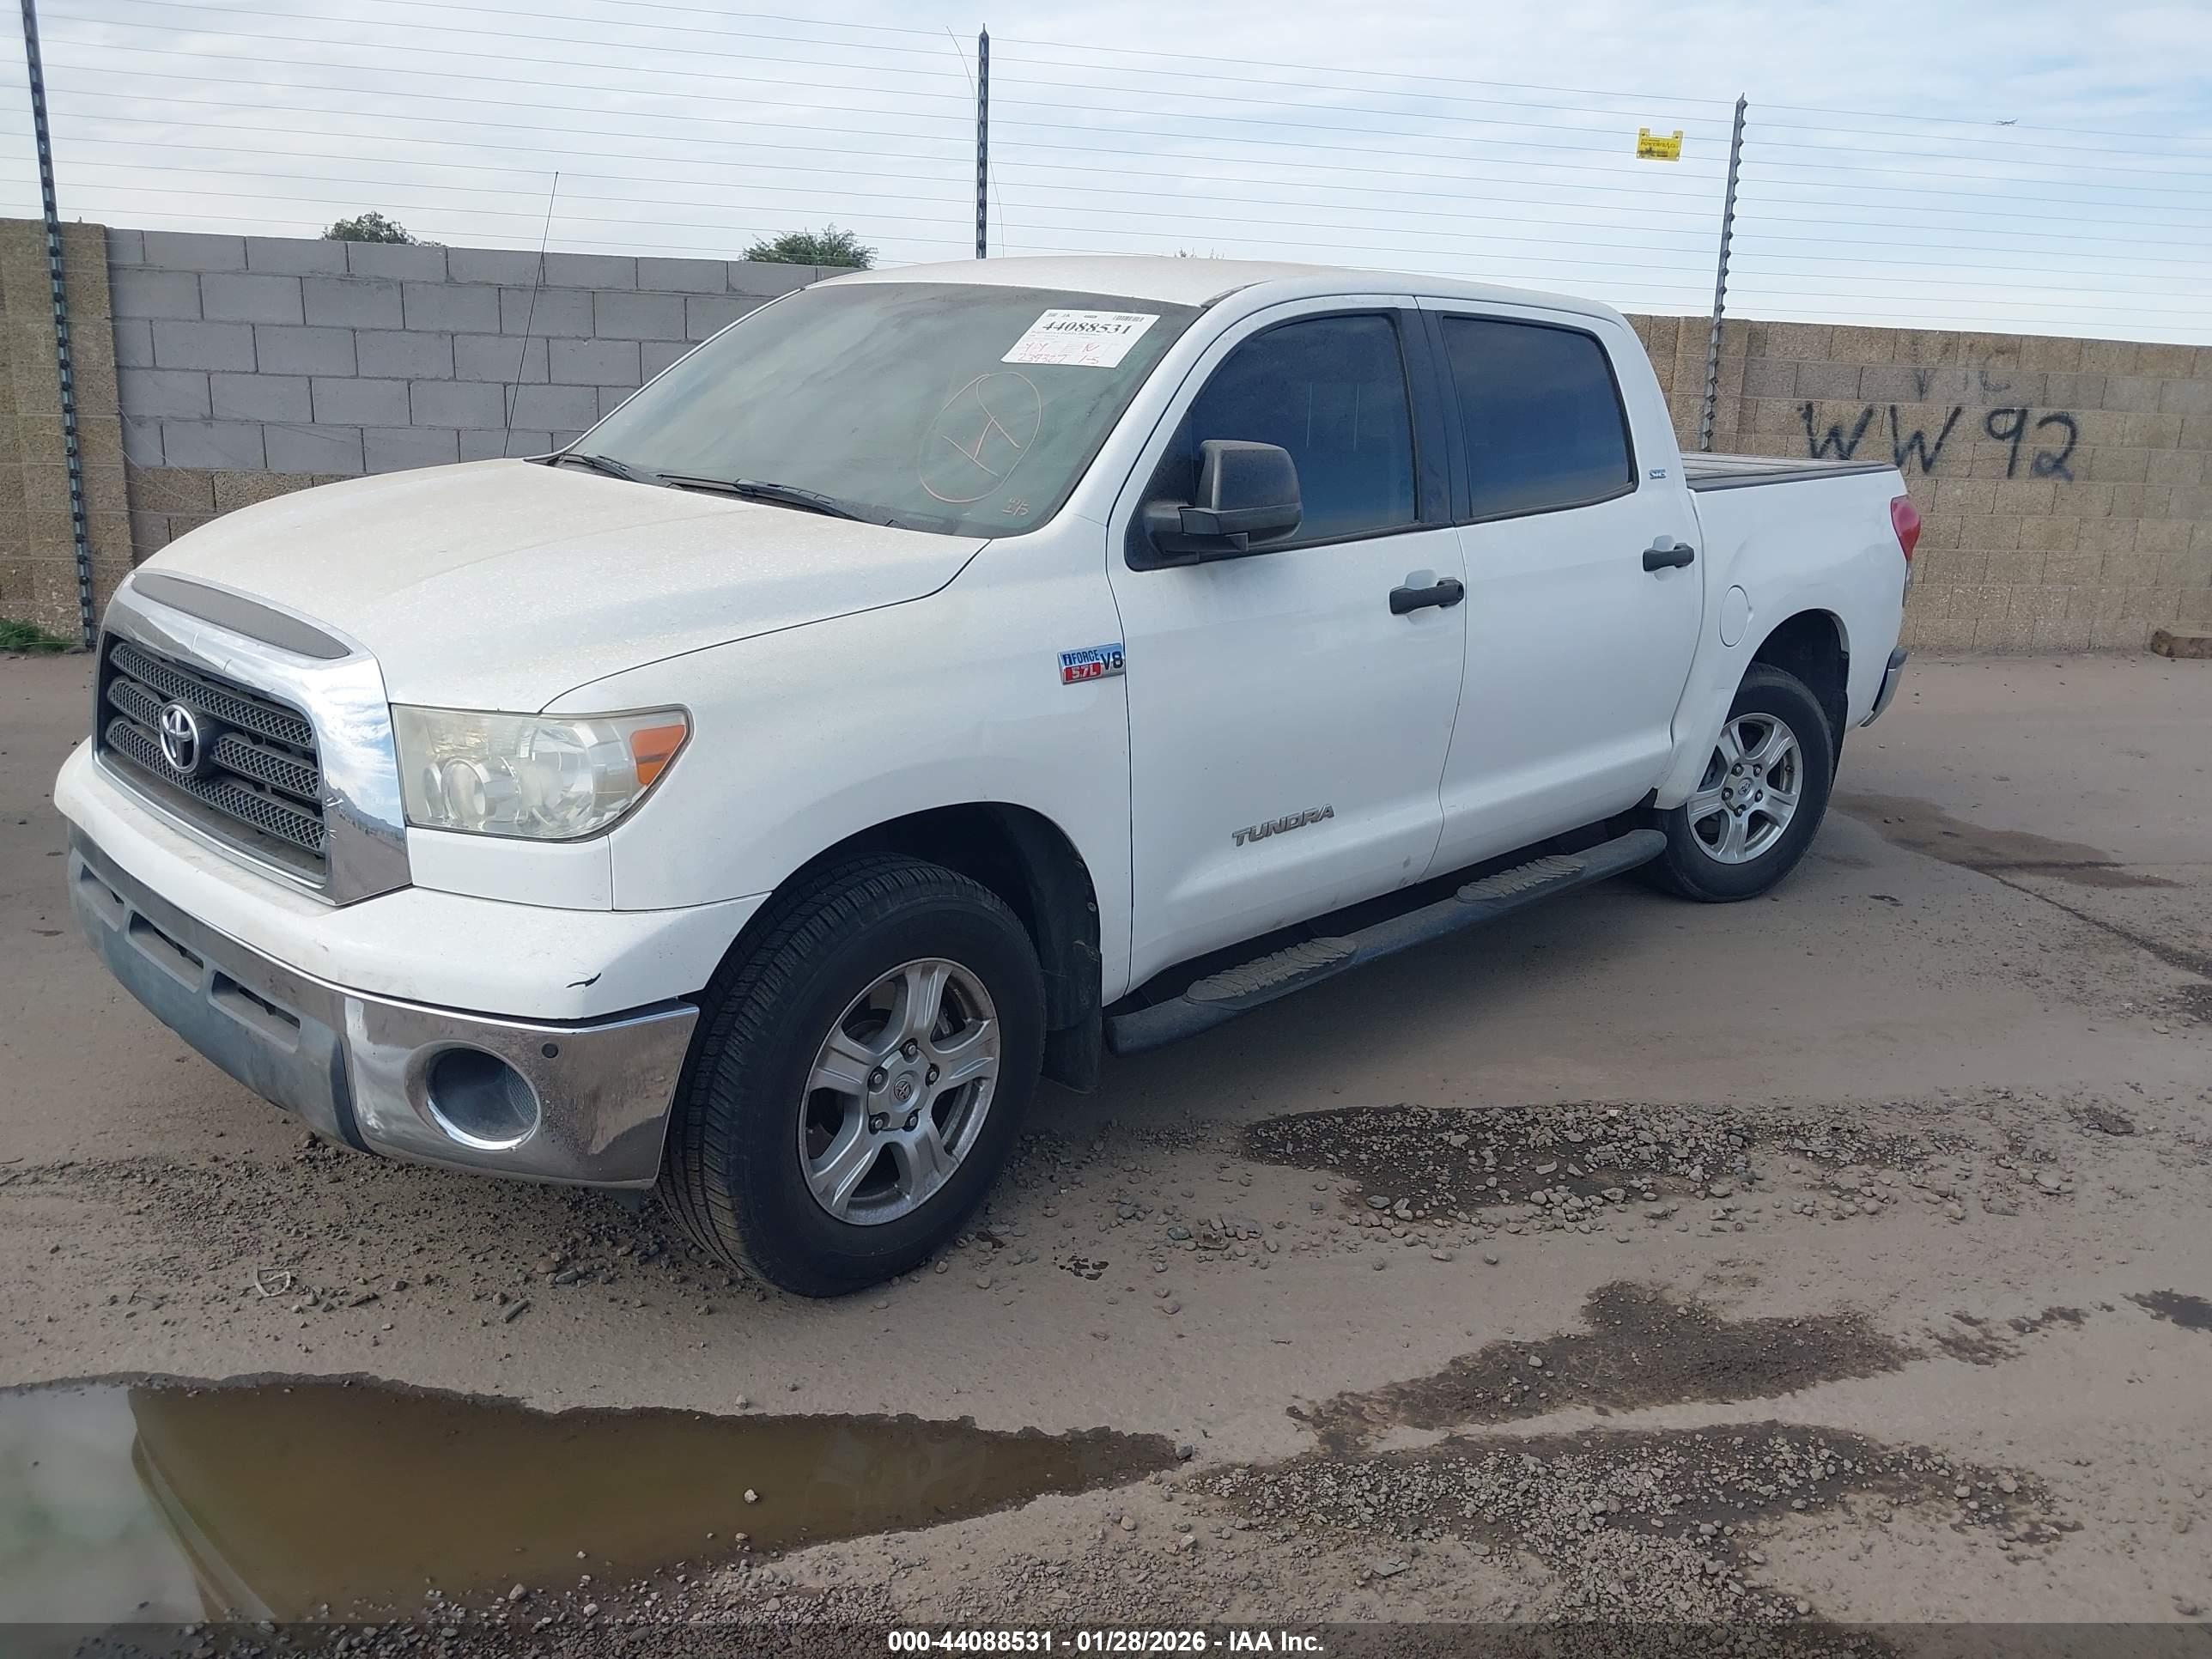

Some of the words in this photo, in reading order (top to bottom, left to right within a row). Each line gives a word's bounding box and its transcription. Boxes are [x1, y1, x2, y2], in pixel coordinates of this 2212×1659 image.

[1042, 321, 1133, 335] 44088531
[1100, 651, 1124, 671] V8
[1231, 804, 1334, 847] TUNDRA
